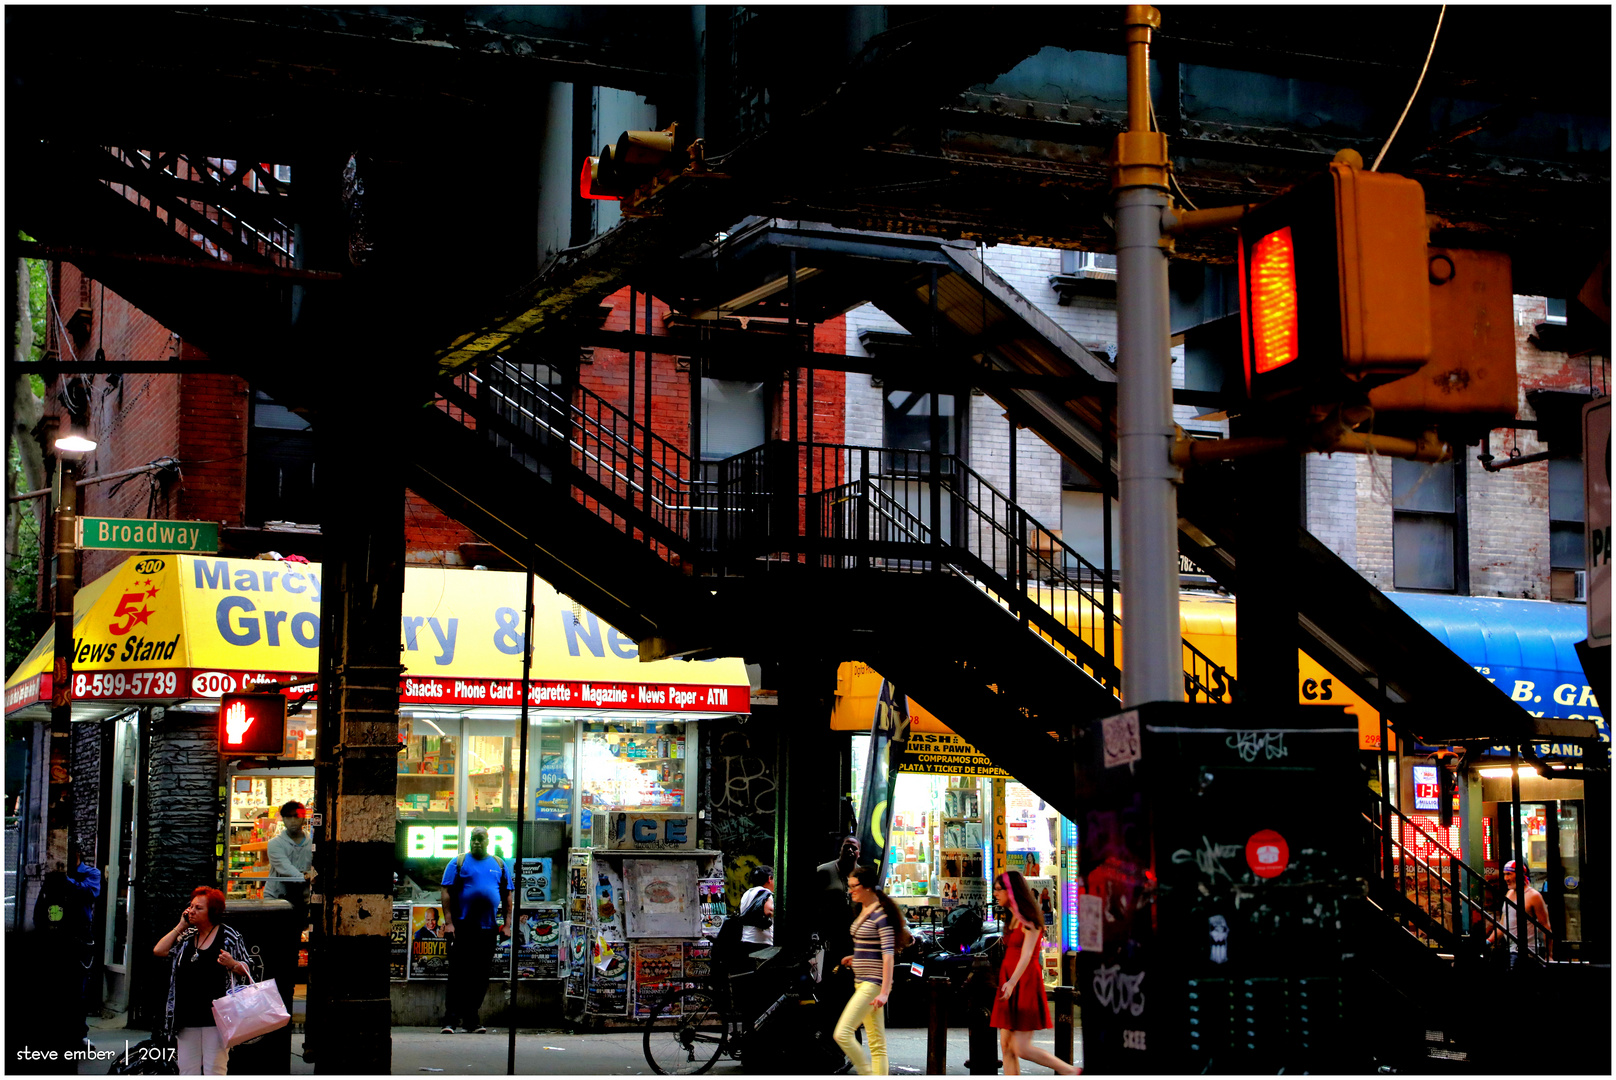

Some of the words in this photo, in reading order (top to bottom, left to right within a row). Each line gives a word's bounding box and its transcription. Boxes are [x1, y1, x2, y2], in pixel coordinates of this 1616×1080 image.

[98, 521, 200, 550] Broadway
[137, 560, 163, 573] 300
[120, 634, 181, 662] Stand
[196, 675, 232, 693] 300
[405, 678, 443, 697] Snacks
[454, 680, 486, 699] Phone
[489, 681, 514, 700] Card
[581, 684, 628, 706] Magazine
[638, 686, 666, 704] News
[668, 687, 697, 708] Paper
[706, 688, 728, 705] ATM
[909, 715, 920, 725] 98
[1365, 734, 1381, 744] 298
[943, 744, 971, 754] PAWN
[918, 754, 971, 764] COMPRAMOS
[972, 757, 993, 767] ORO,
[899, 763, 925, 772] PLATA
[926, 764, 933, 772] Y
[934, 765, 963, 773] TICKET
[965, 766, 976, 774] DE
[542, 773, 557, 784] 960
[616, 813, 688, 845] ICE
[995, 815, 1004, 869] CALL
[413, 941, 438, 955] RUBBY
